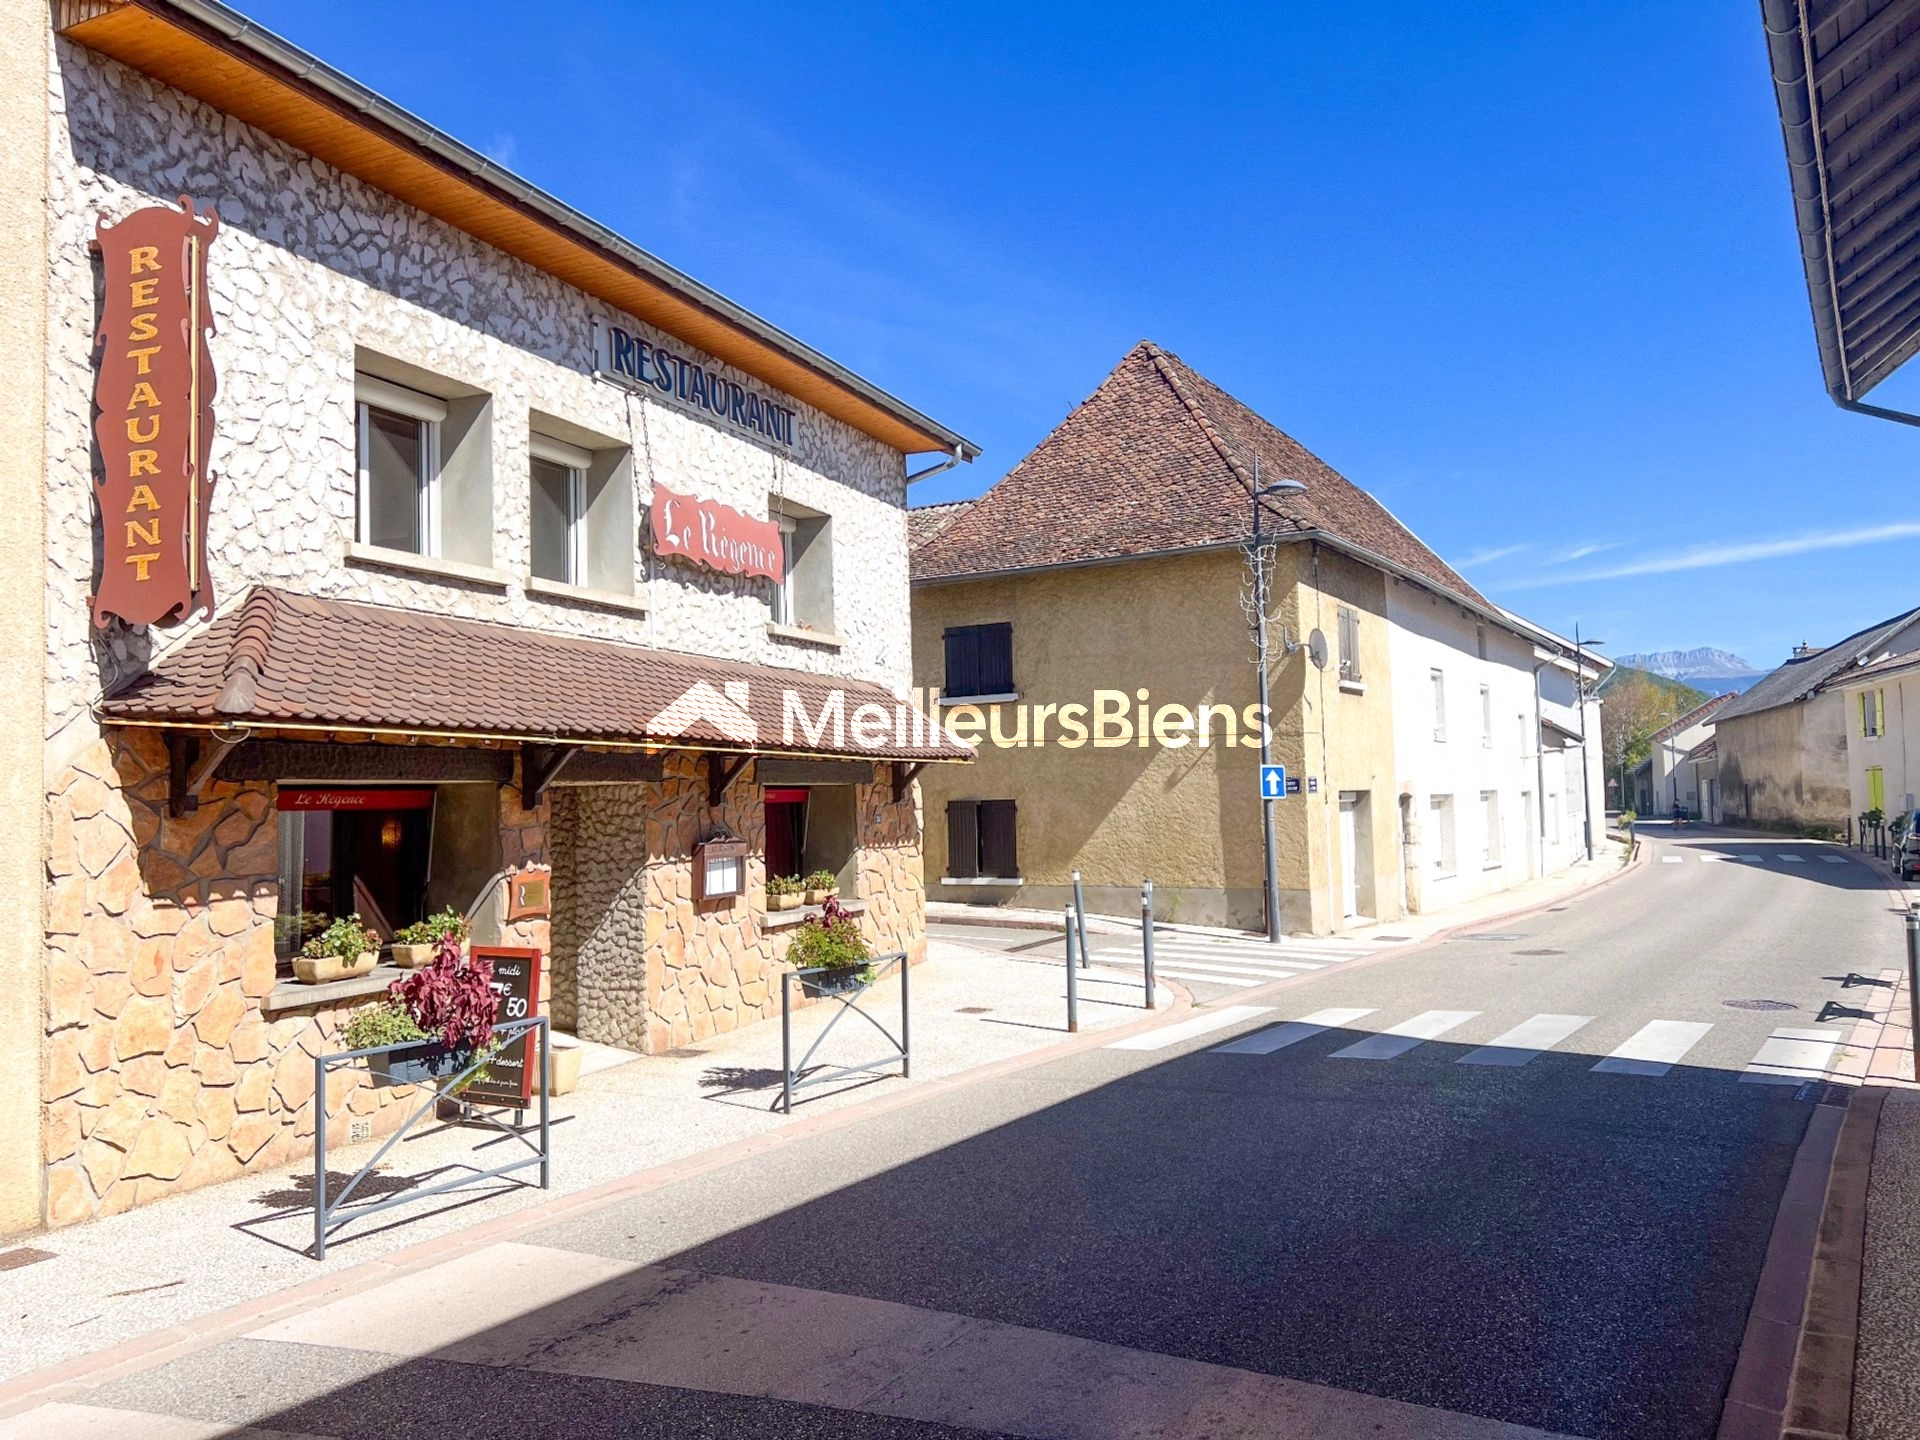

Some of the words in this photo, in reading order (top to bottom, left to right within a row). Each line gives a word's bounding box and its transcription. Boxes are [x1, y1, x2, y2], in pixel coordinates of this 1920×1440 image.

[609, 327, 796, 447] RESTAURANT
[124, 246, 163, 582] RESTAURANT
[664, 499, 691, 550] Le
[294, 793, 312, 805] Le
[498, 964, 522, 976] midi
[506, 997, 528, 1018] 50
